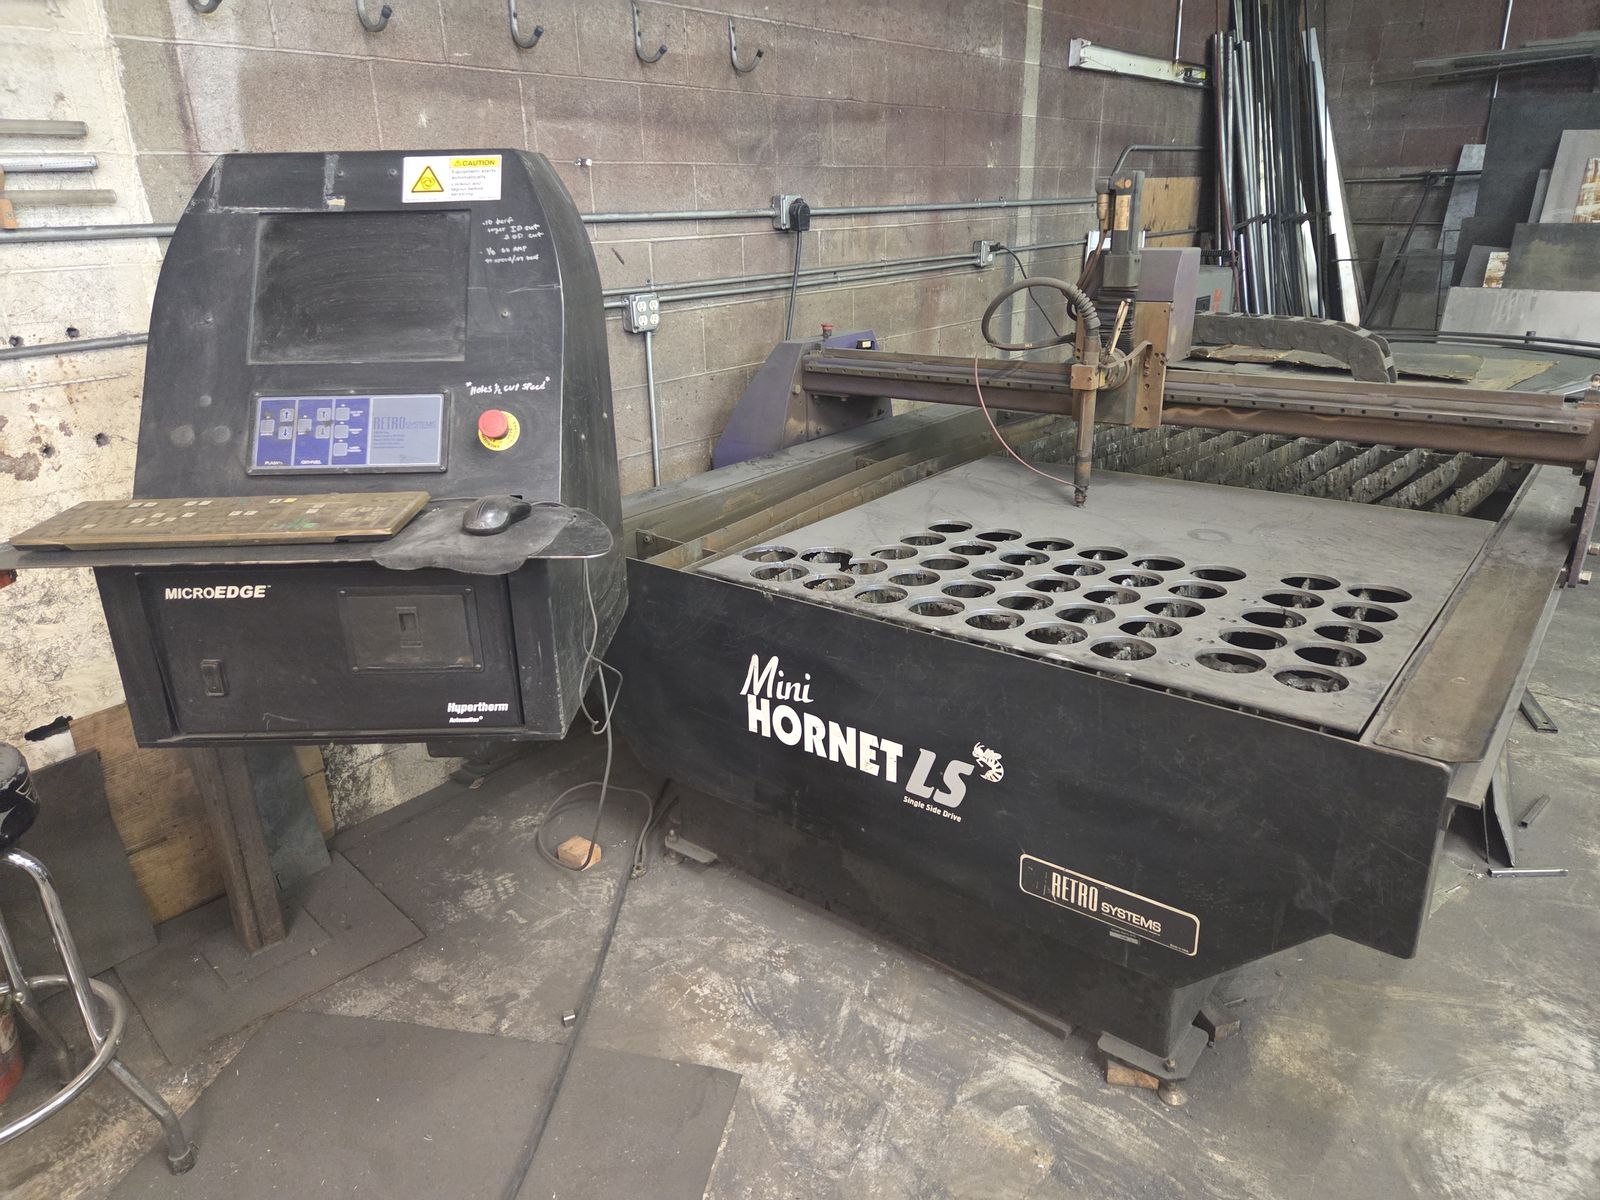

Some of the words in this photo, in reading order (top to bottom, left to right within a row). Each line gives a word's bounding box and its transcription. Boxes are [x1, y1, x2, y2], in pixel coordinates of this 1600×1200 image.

[462, 159, 496, 167] CAUTION
[373, 416, 406, 430] RETRO
[165, 584, 268, 600] MICROEDGE
[740, 653, 814, 703] Mini
[447, 701, 509, 715] Hypertherm
[747, 693, 904, 784] HORNET
[906, 747, 975, 809] LS
[903, 795, 925, 809] Single
[925, 803, 942, 815] Side
[942, 809, 962, 823] Drive
[1051, 871, 1099, 912] RETRO
[1101, 902, 1162, 933] SYSTEMS
